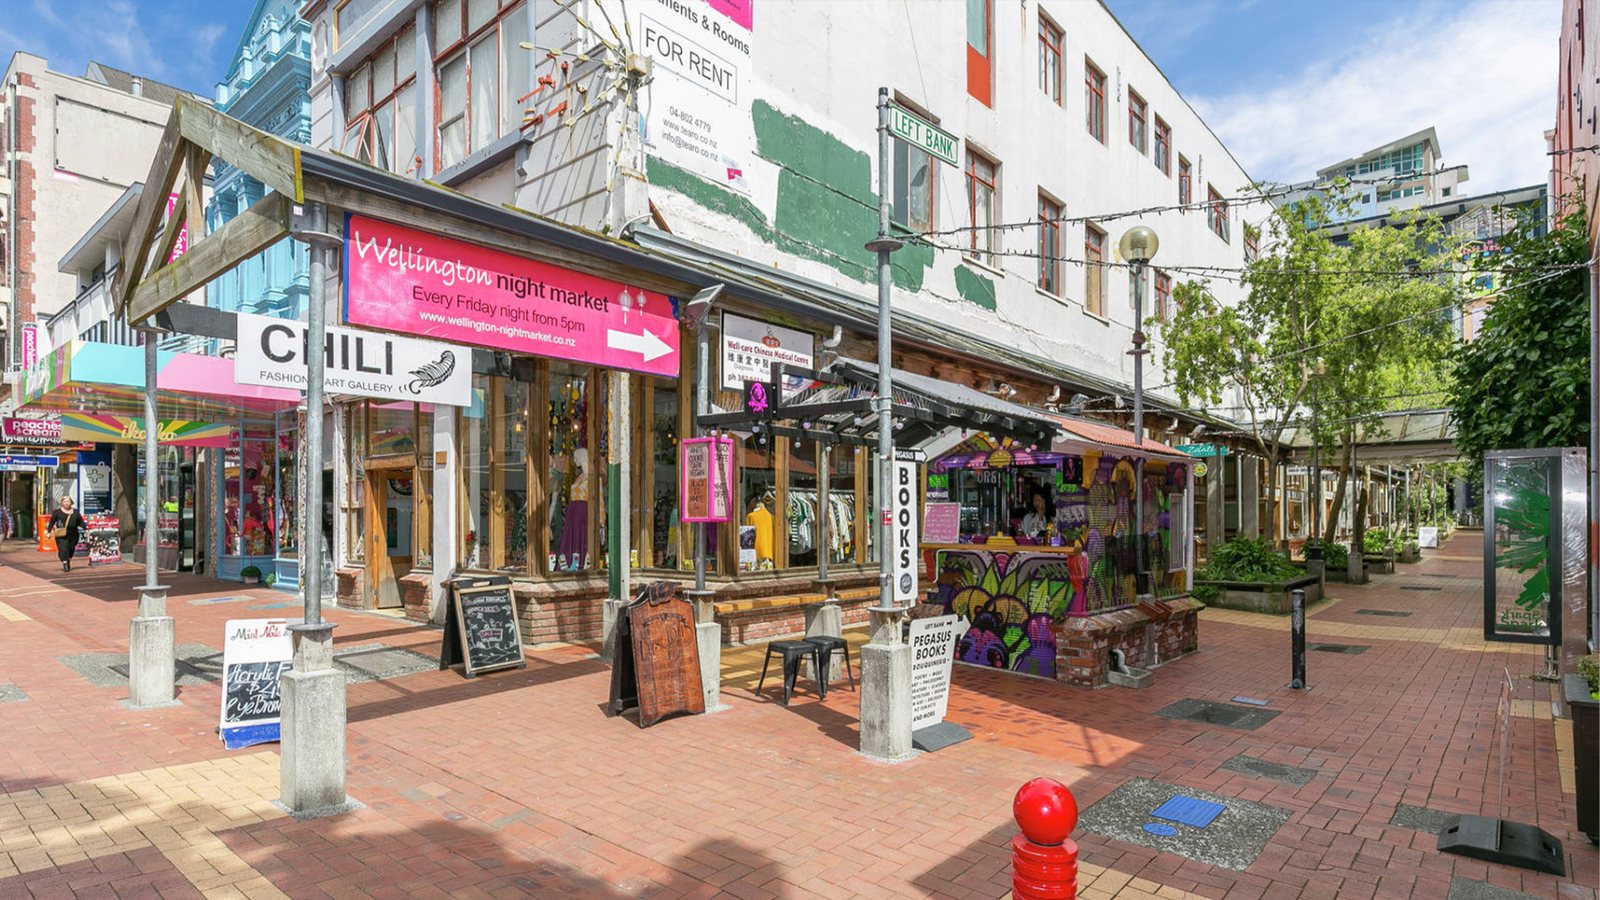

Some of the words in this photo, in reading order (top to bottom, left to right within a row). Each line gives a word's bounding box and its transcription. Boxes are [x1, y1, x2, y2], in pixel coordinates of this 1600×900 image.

[658, 0, 698, 23] ments
[701, 15, 710, 31] &
[713, 21, 750, 55] Rooms
[645, 27, 684, 67] FOR
[689, 51, 734, 92] RENT
[662, 118, 718, 149] www.tearo.co.nz
[669, 106, 694, 126] 04-802
[694, 118, 712, 133] 4779
[895, 111, 921, 141] LEFT
[925, 128, 953, 159] BANK
[661, 130, 719, 161] info@tearo.co.nz
[354, 230, 493, 286] Wellington
[497, 273, 546, 299] night
[549, 287, 610, 313] market
[412, 285, 453, 310] Every
[456, 294, 498, 318] Friday
[500, 305, 530, 323] night
[532, 309, 559, 327] from
[560, 316, 586, 333] 5pm
[419, 311, 577, 347] www.wellington-nightmarket.co.nz
[260, 324, 393, 376] CHILI
[727, 340, 753, 353] Well-care
[753, 346, 774, 357] Chinese
[774, 350, 793, 361] Medical
[260, 370, 309, 384] FASHION
[325, 378, 345, 388] ART
[348, 380, 393, 393] GALLERY
[12, 420, 63, 435] peaches
[22, 427, 61, 437] cream
[898, 467, 911, 569] BOOKS
[913, 630, 952, 648] PEGASUS
[916, 644, 947, 660] BOOKS
[226, 663, 275, 684] Acrylic
[913, 714, 923, 722] AND
[923, 711, 936, 719] MORE
